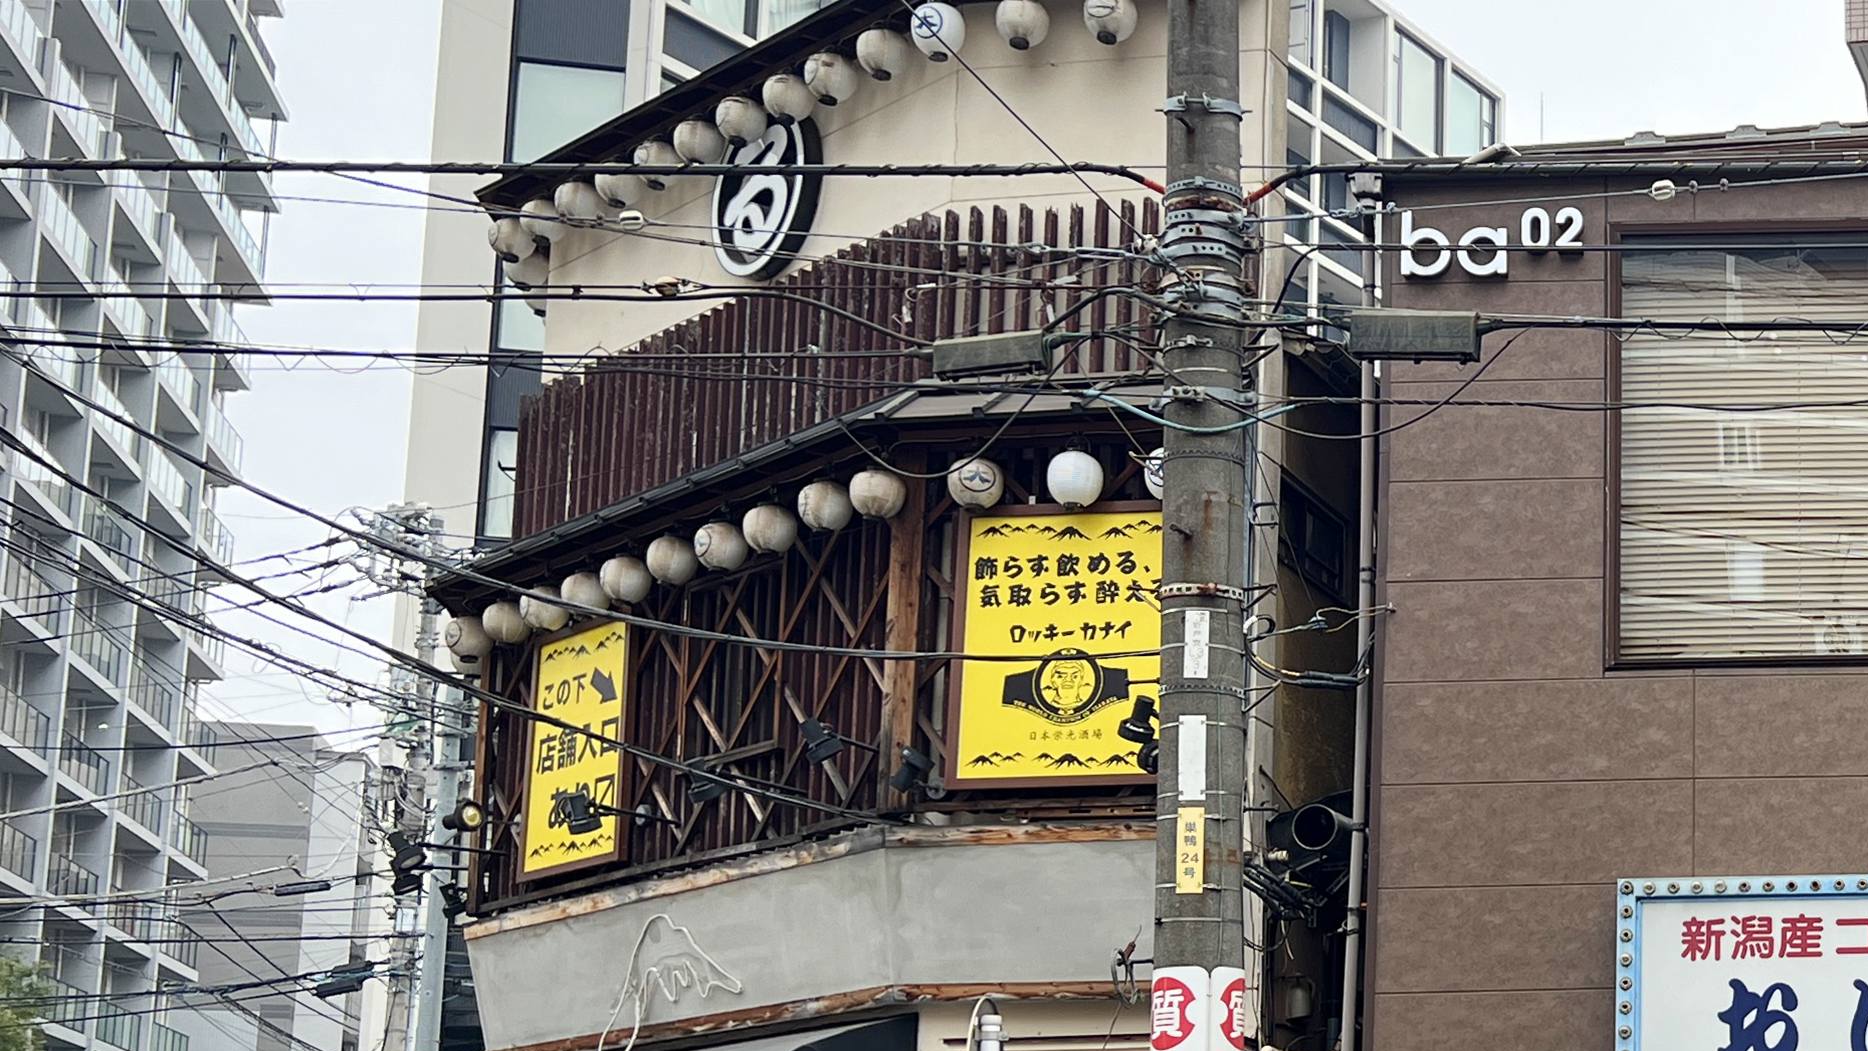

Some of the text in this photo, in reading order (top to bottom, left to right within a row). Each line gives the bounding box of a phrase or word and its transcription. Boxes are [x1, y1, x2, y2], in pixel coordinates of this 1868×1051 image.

[1401, 207, 1583, 276] ba 02
[975, 550, 1151, 580] 飾らず飲める、
[1010, 621, 1132, 643] ロッキーカナイ
[543, 673, 587, 710] この下
[537, 716, 619, 775] 店舗入口
[1152, 989, 1184, 1039] 質
